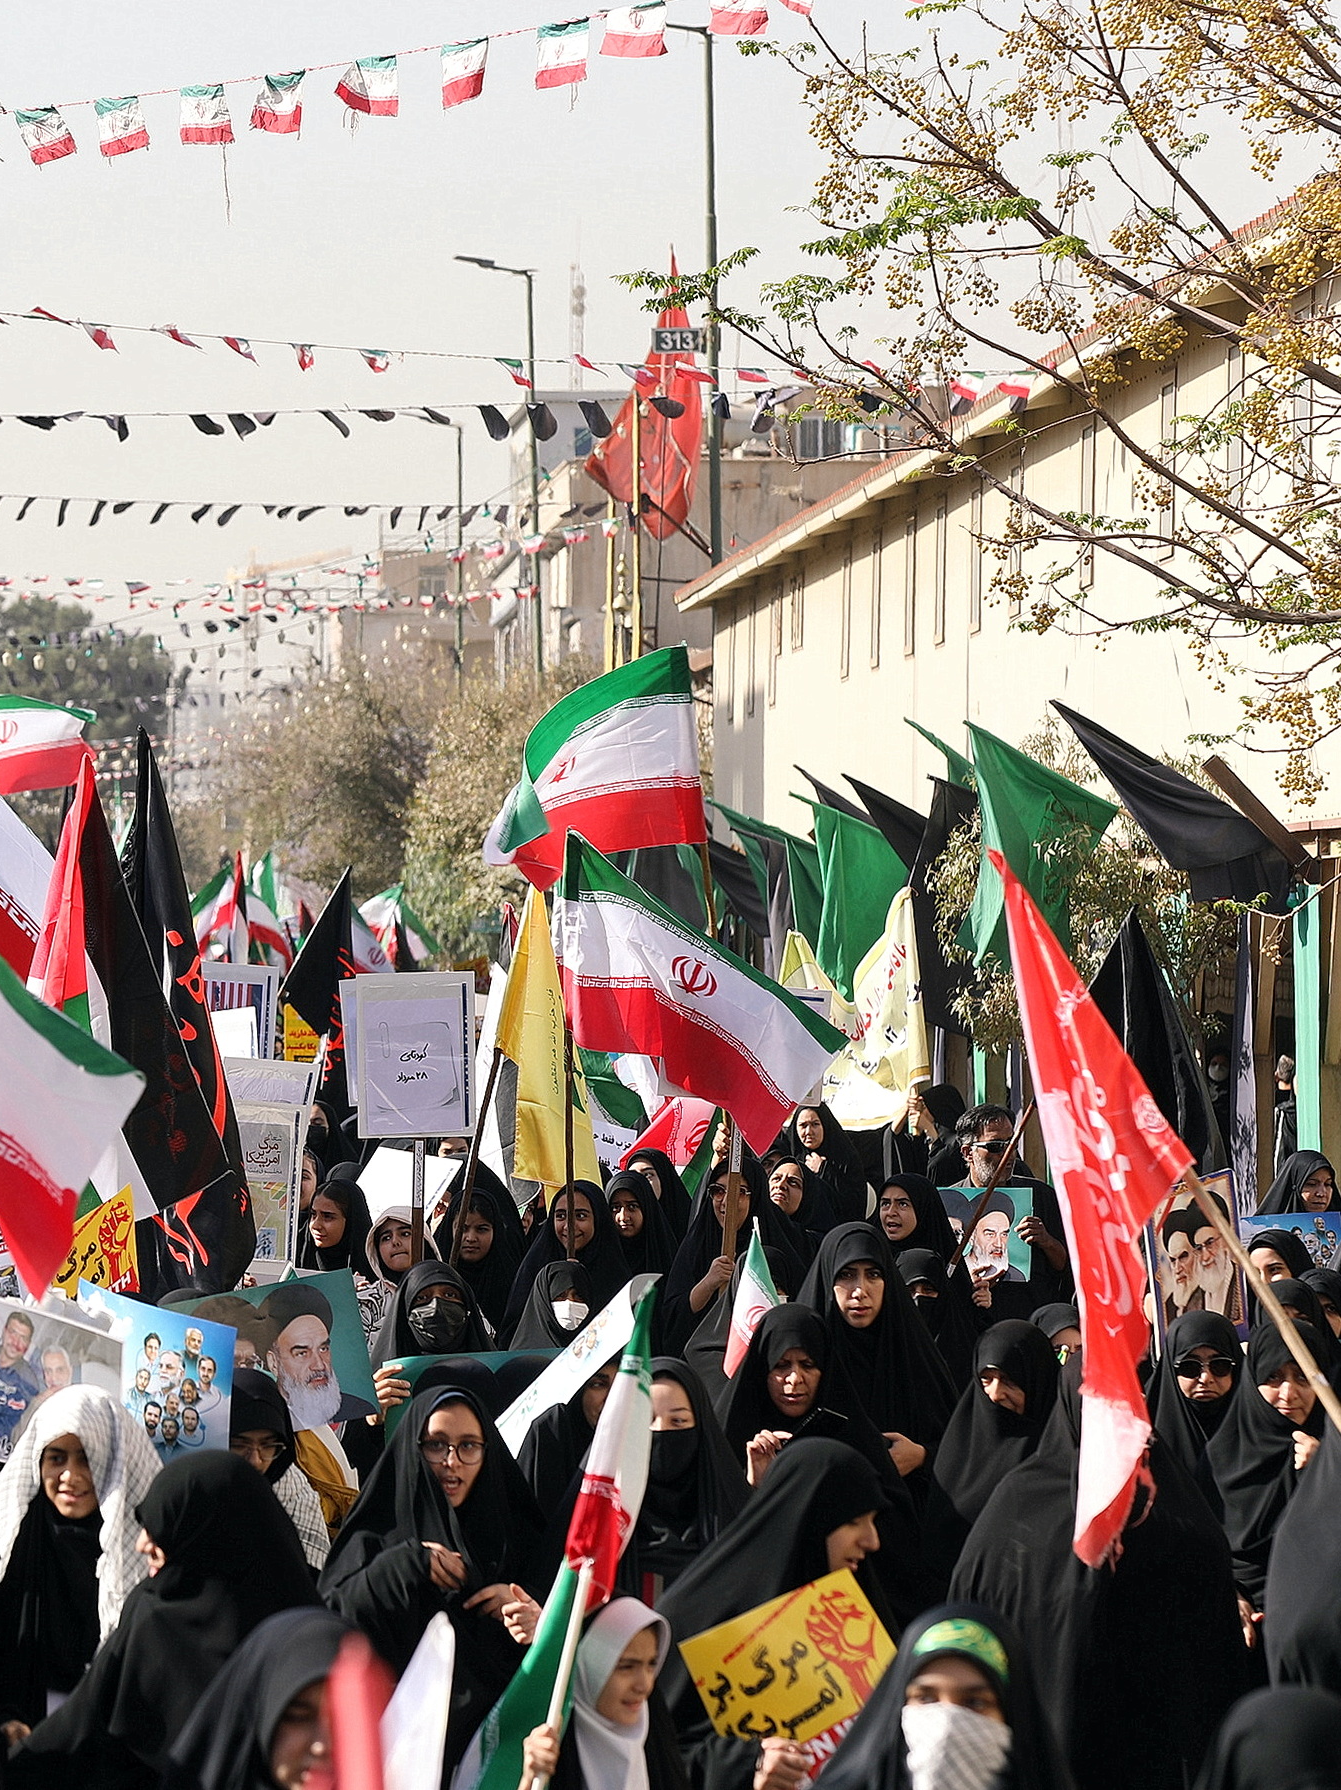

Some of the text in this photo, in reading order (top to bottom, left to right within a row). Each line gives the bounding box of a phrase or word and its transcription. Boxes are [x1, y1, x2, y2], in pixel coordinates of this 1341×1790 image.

[660, 331, 694, 350] 313
[258, 1136, 279, 1154] مرگ
[246, 1150, 282, 1168] آمریکا
[708, 1640, 808, 1719] مرگ بر
